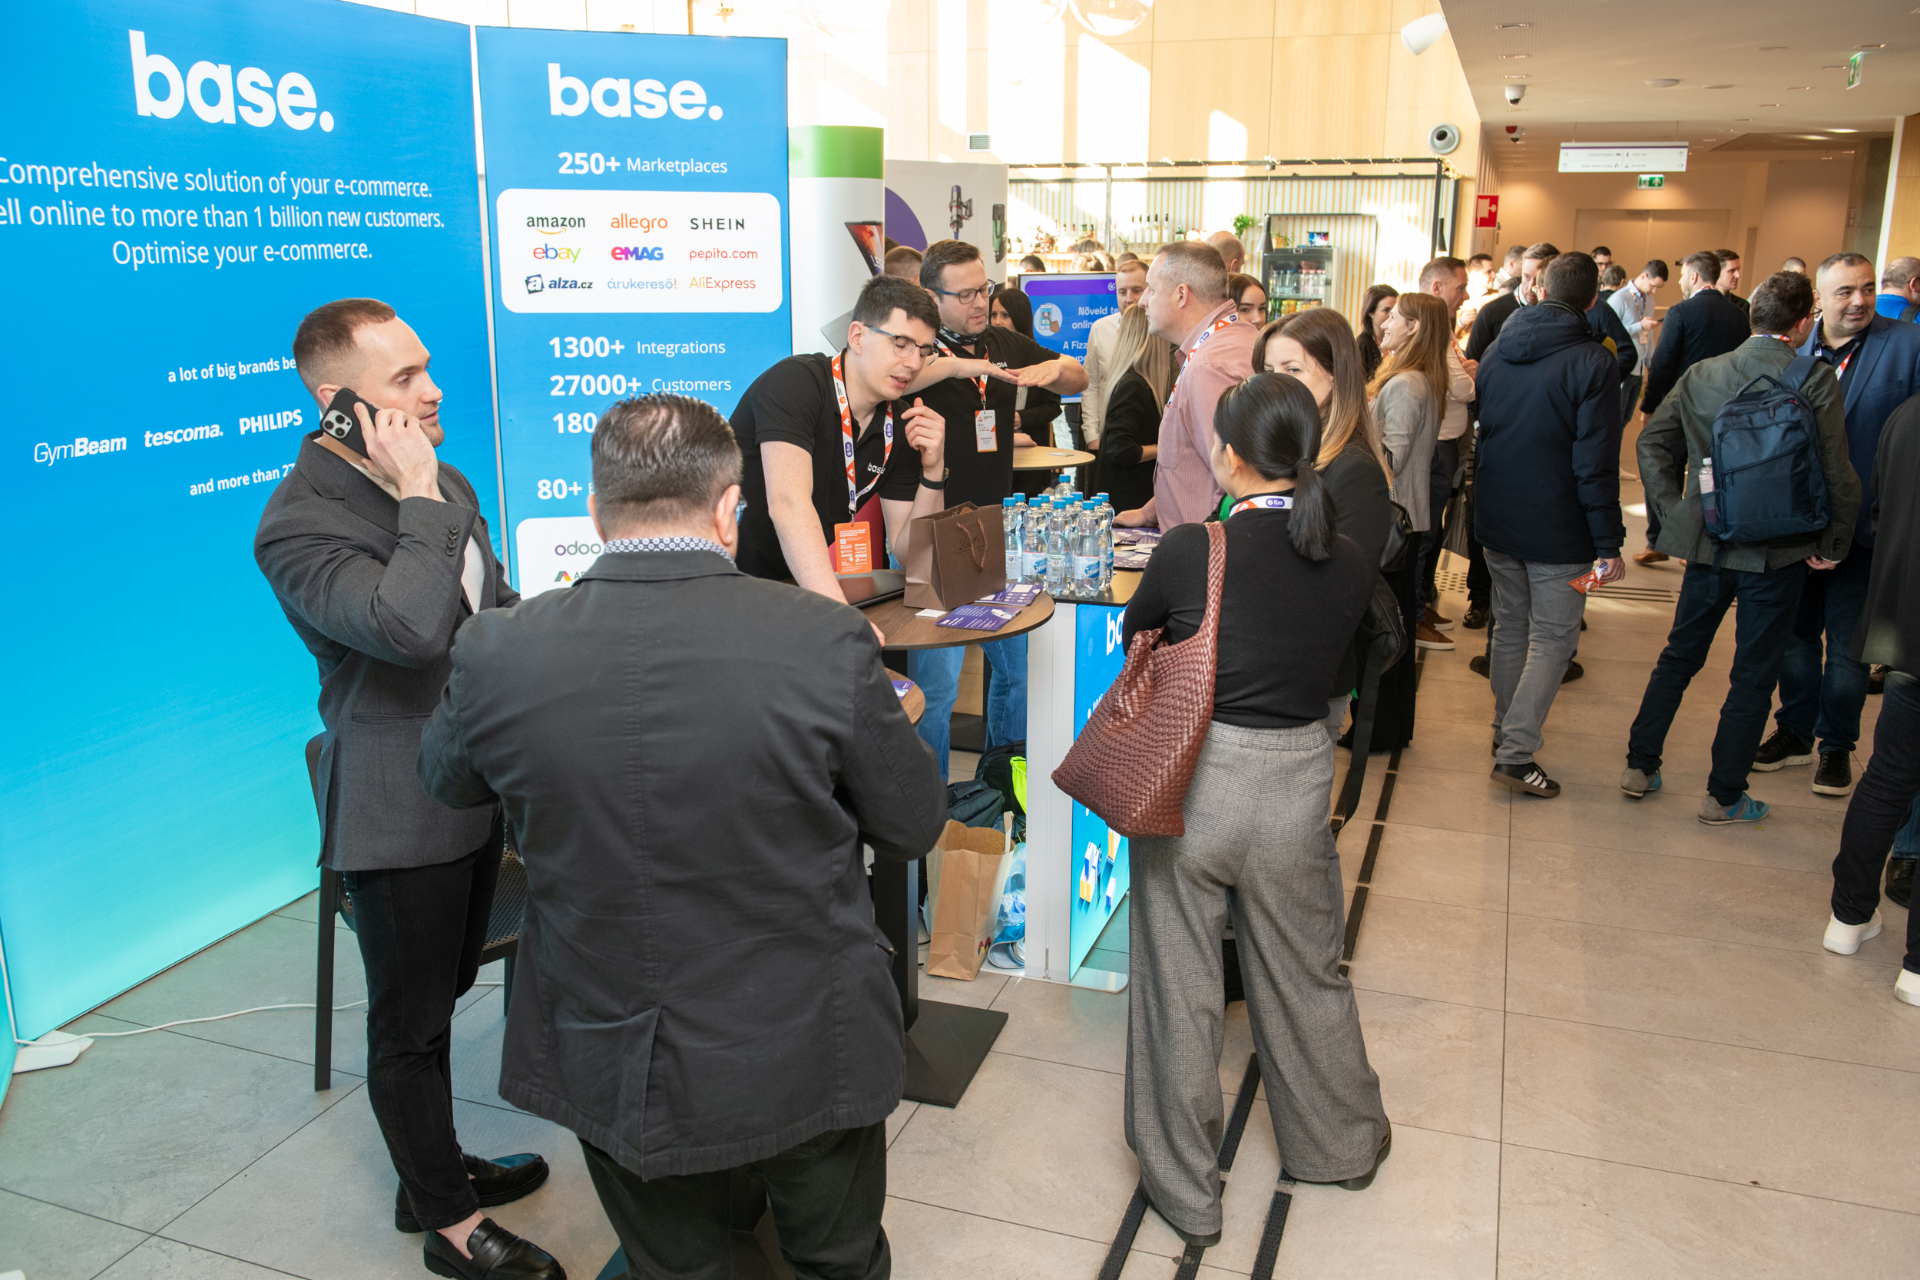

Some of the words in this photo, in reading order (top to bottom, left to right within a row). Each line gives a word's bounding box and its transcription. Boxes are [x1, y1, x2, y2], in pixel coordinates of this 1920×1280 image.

[129, 29, 334, 132] base.
[548, 63, 723, 120] base.
[558, 152, 620, 174] 250+
[627, 158, 727, 176] Marketplaces
[185, 168, 263, 193] solution
[269, 171, 286, 193] of
[290, 177, 330, 199] your
[335, 178, 432, 198] e-commerce.
[30, 200, 105, 226] online
[111, 204, 134, 226] to
[142, 209, 197, 227] more
[203, 204, 248, 228] than
[254, 206, 262, 228] 1
[270, 205, 322, 227] billion
[328, 211, 360, 227] new
[365, 209, 444, 228] customers.
[527, 217, 586, 228] amazon
[611, 213, 668, 233] allegro
[690, 218, 745, 230] SHEIN
[113, 241, 209, 271] Optimise
[214, 246, 257, 269] your
[264, 242, 372, 262] e-commerce.
[533, 243, 581, 263] ebay
[611, 247, 664, 261] eMAG
[690, 248, 758, 261] pepita.com
[548, 277, 593, 289] alza.cz
[607, 276, 677, 290] árukereső!
[690, 277, 756, 292] AliExpress
[1078, 306, 1108, 316] Növeld
[549, 337, 624, 358] 1300+
[638, 341, 725, 357] Integrations
[1063, 341, 1069, 350] A
[168, 371, 176, 382] a
[179, 367, 198, 381] lot
[201, 364, 214, 379] of
[217, 363, 236, 380] big
[238, 358, 280, 375] brands
[550, 374, 641, 396] 27000+
[651, 379, 732, 392] Customers
[34, 437, 126, 466] GymBeam
[144, 423, 223, 447] tescoma.
[239, 409, 303, 434] PHILIPS
[190, 478, 214, 495] and
[217, 475, 250, 491] more
[252, 469, 280, 483] than
[538, 479, 582, 499] 80+
[555, 540, 601, 556] odoo
